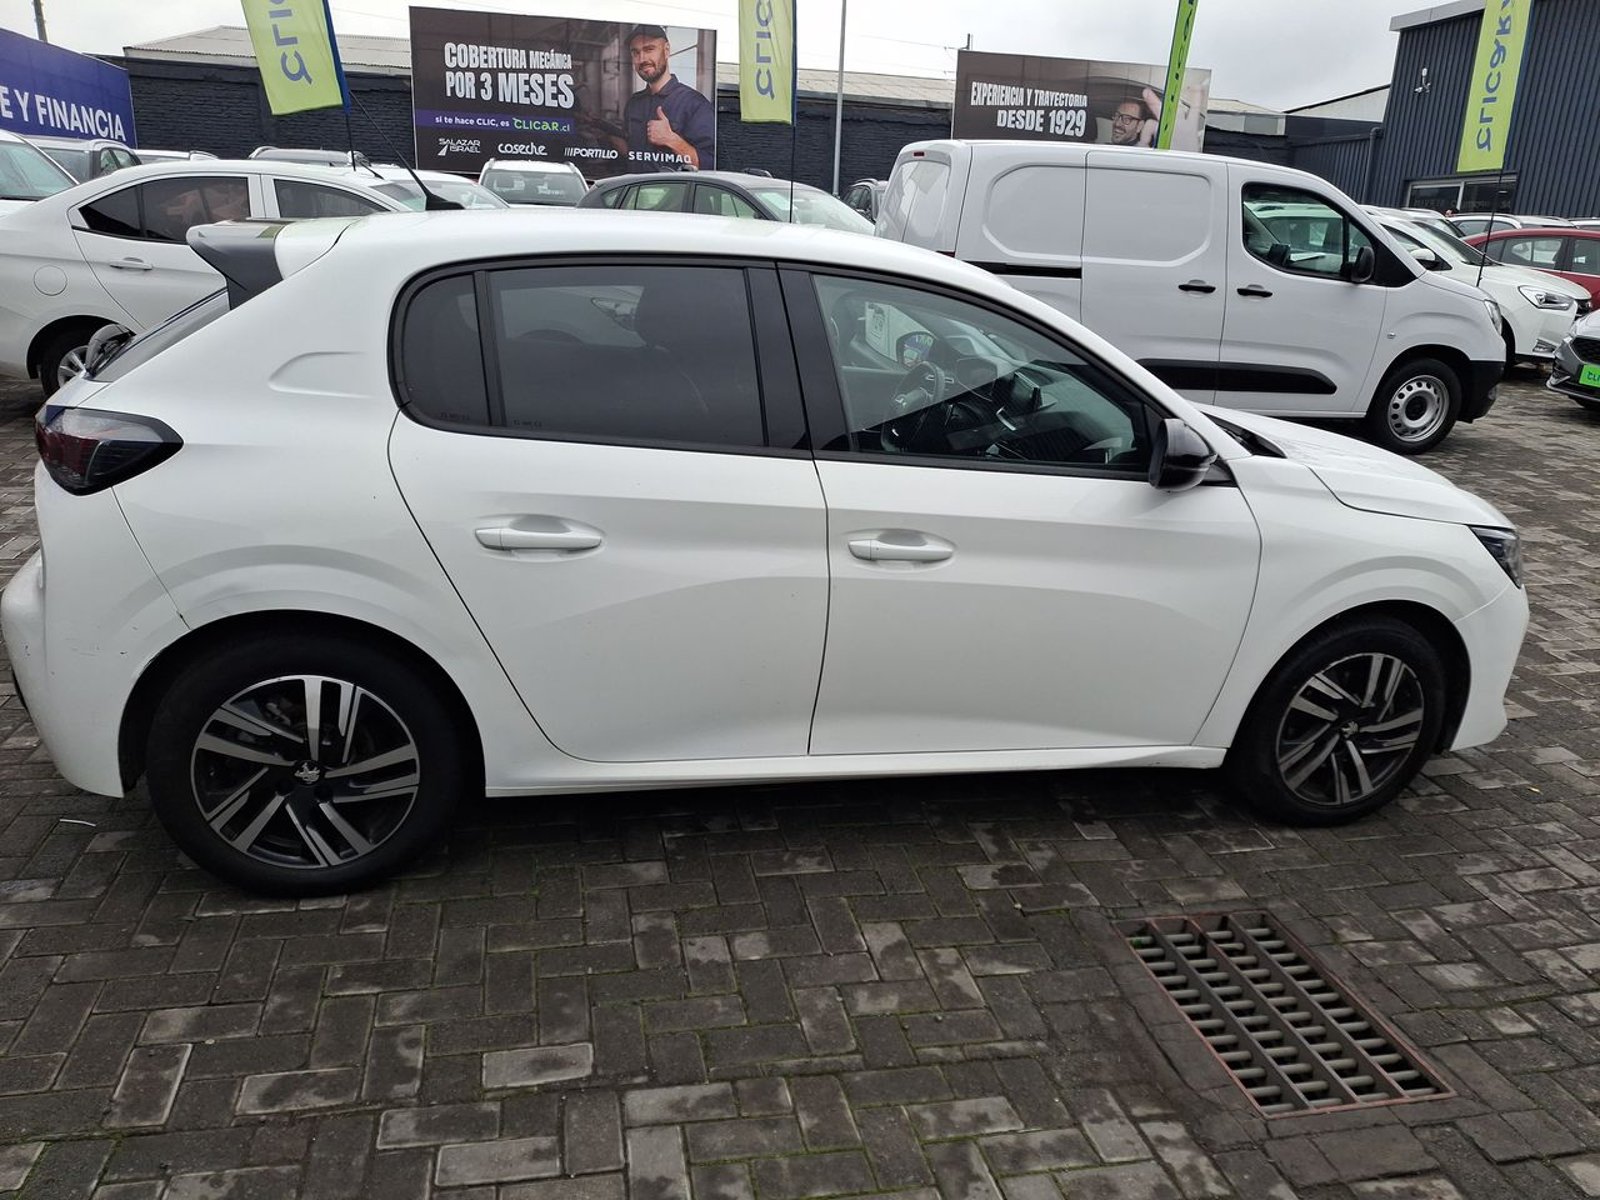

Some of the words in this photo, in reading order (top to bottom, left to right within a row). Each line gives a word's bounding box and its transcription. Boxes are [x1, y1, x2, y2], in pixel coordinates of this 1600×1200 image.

[444, 42, 527, 69] COBERTURA
[529, 49, 572, 70] MECÁNICA
[445, 71, 476, 99] POR
[480, 72, 493, 101] 3
[498, 72, 575, 109] MESES
[970, 81, 1024, 107] EXPERIENCIA
[1026, 88, 1034, 107] Y
[1034, 89, 1088, 108] TRAYECTORIA
[14, 89, 29, 122] Y
[34, 94, 126, 141] FINANCIA
[435, 115, 442, 123] si
[444, 116, 453, 124] te
[454, 116, 474, 125] hace
[476, 118, 498, 128] CLIC,
[996, 109, 1044, 132] DESDE
[1048, 110, 1086, 138] 1929
[438, 138, 481, 146] SALAZAR
[449, 144, 481, 153] ISRAEL
